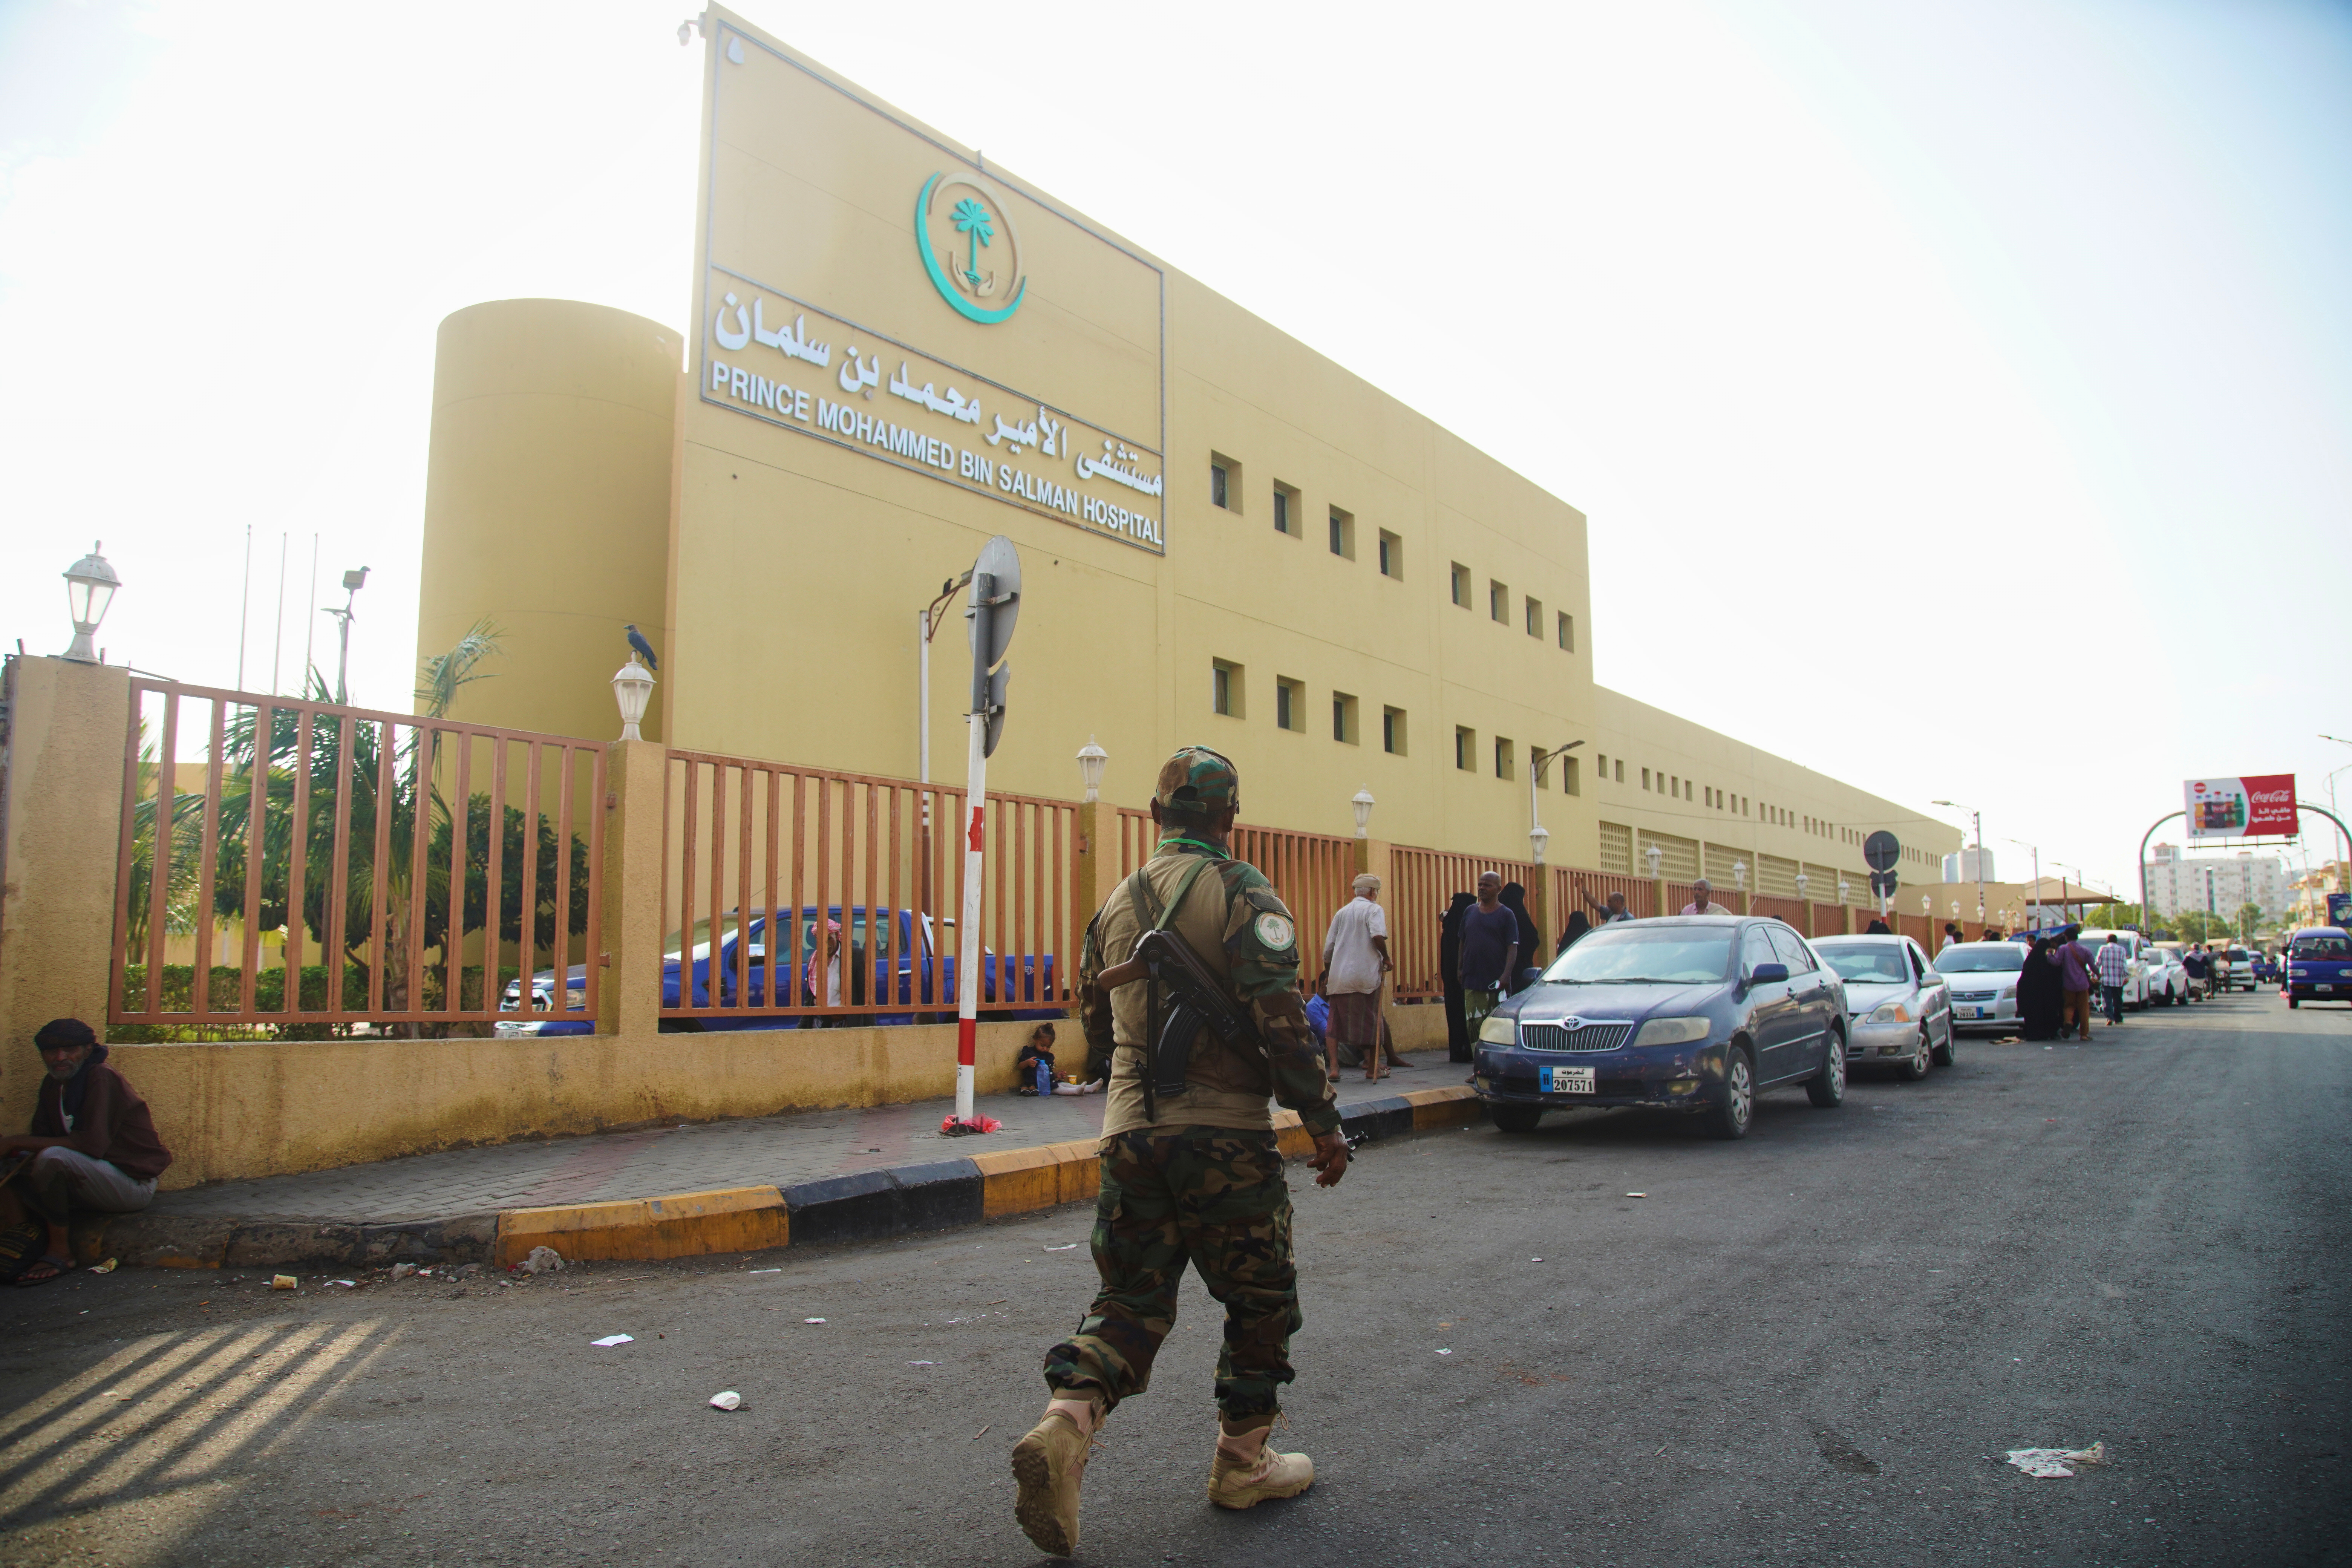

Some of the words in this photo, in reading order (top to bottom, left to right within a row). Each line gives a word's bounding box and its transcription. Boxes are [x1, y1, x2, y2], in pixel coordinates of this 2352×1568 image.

[715, 292, 830, 368] سلمان
[839, 346, 880, 400] بن
[890, 361, 980, 424] محمد
[711, 360, 810, 421] PRINCE
[818, 398, 954, 470] MOHAMMED
[959, 450, 993, 485] BIN
[998, 464, 1078, 515] SALMAN
[1082, 495, 1163, 545] HOSPITAL
[984, 406, 1067, 459] الأمير
[1076, 439, 1162, 497] مستشفى
[1543, 1074, 1549, 1085] H
[1554, 1080, 1592, 1092] 207571
